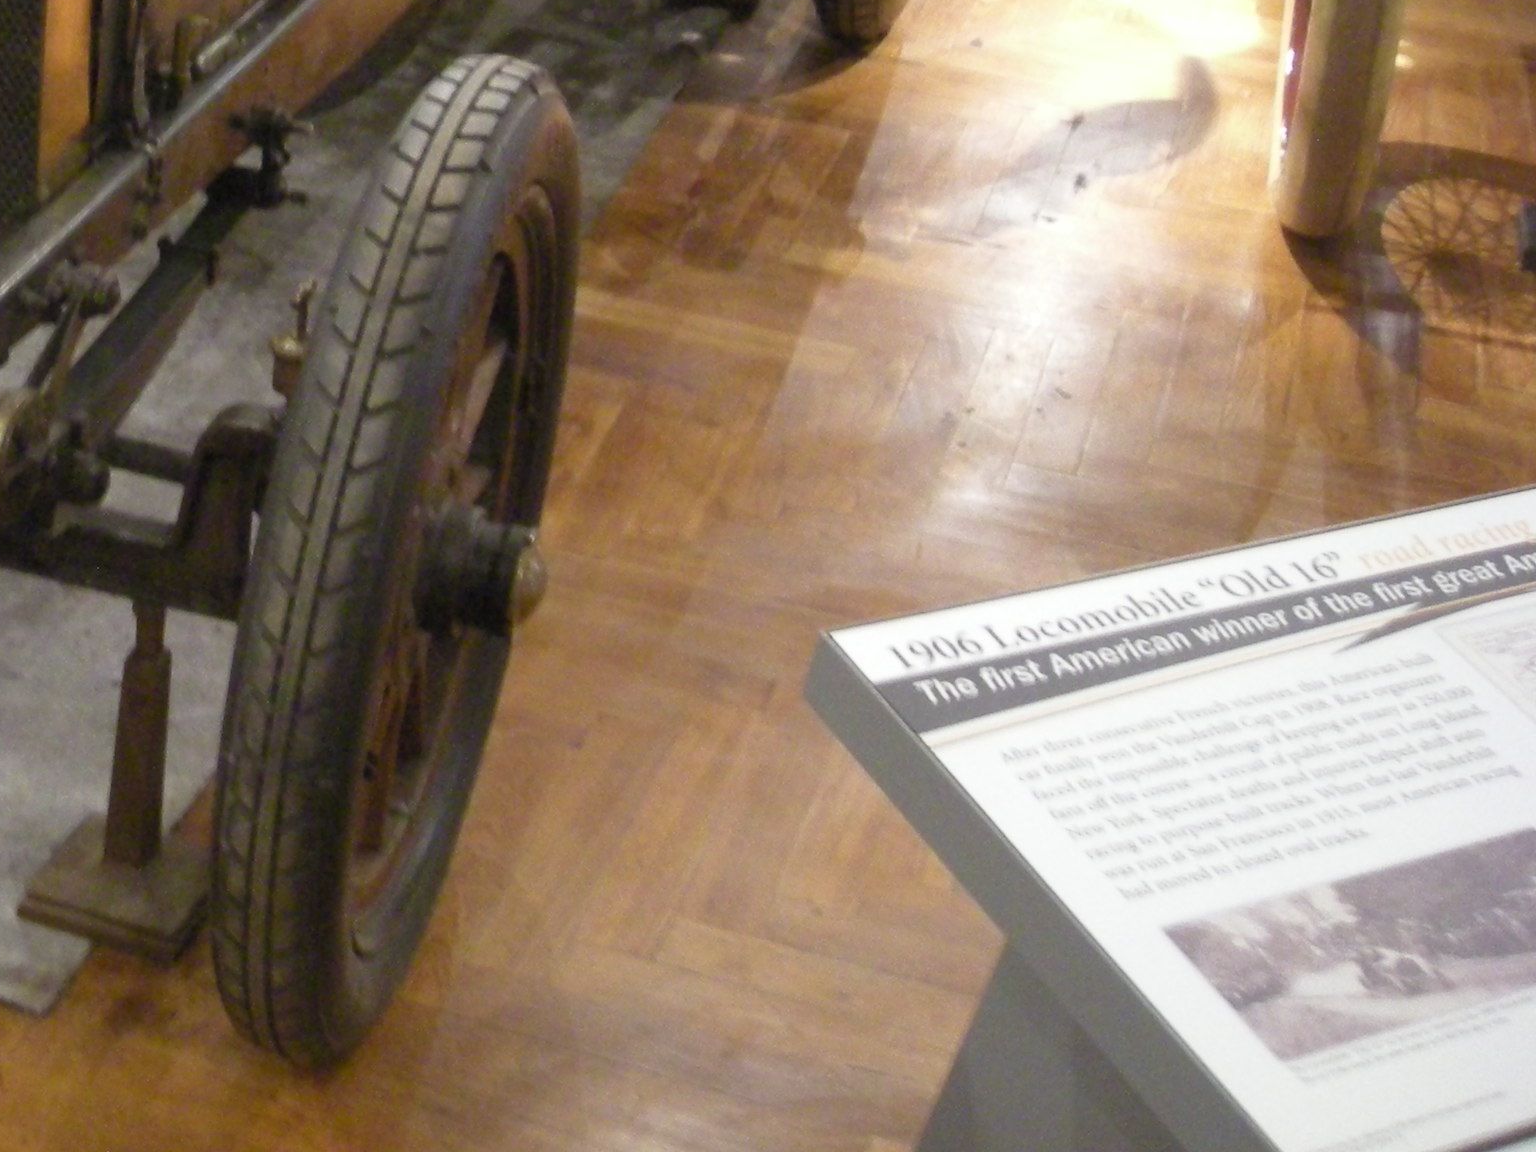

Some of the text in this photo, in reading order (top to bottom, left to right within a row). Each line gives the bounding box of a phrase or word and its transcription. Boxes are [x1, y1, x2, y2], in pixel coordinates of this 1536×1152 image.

[890, 630, 984, 669] 1906
[983, 588, 1203, 649] Locomobile
[914, 676, 979, 706] The
[979, 659, 1049, 694] first
[1049, 630, 1192, 679] American
[1191, 609, 1290, 646] winner
[1293, 600, 1323, 621] of
[1322, 590, 1375, 617] the
[1374, 575, 1434, 603] first
[1432, 561, 1505, 595] great
